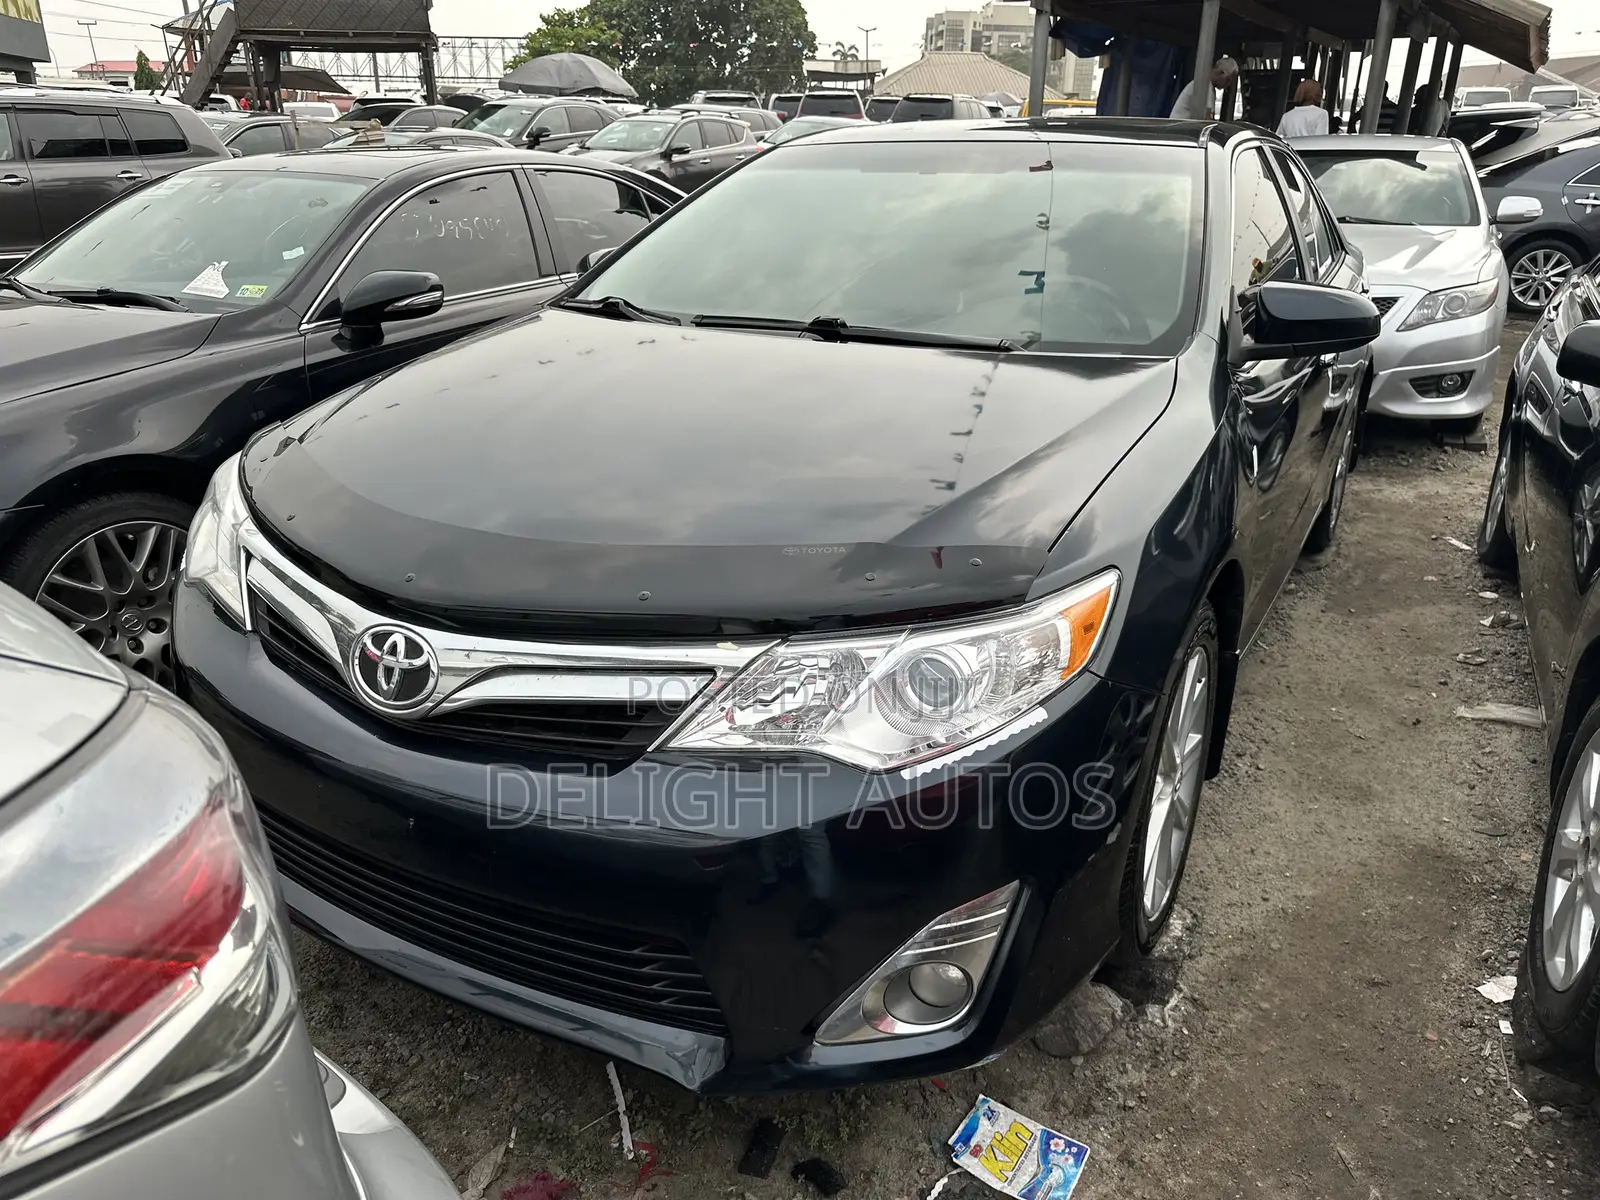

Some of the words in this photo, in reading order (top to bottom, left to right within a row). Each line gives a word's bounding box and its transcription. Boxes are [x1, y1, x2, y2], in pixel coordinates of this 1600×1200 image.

[801, 546, 847, 554] TOYOTA
[983, 1105, 997, 1121] 2X
[979, 1121, 1034, 1183] Klin
